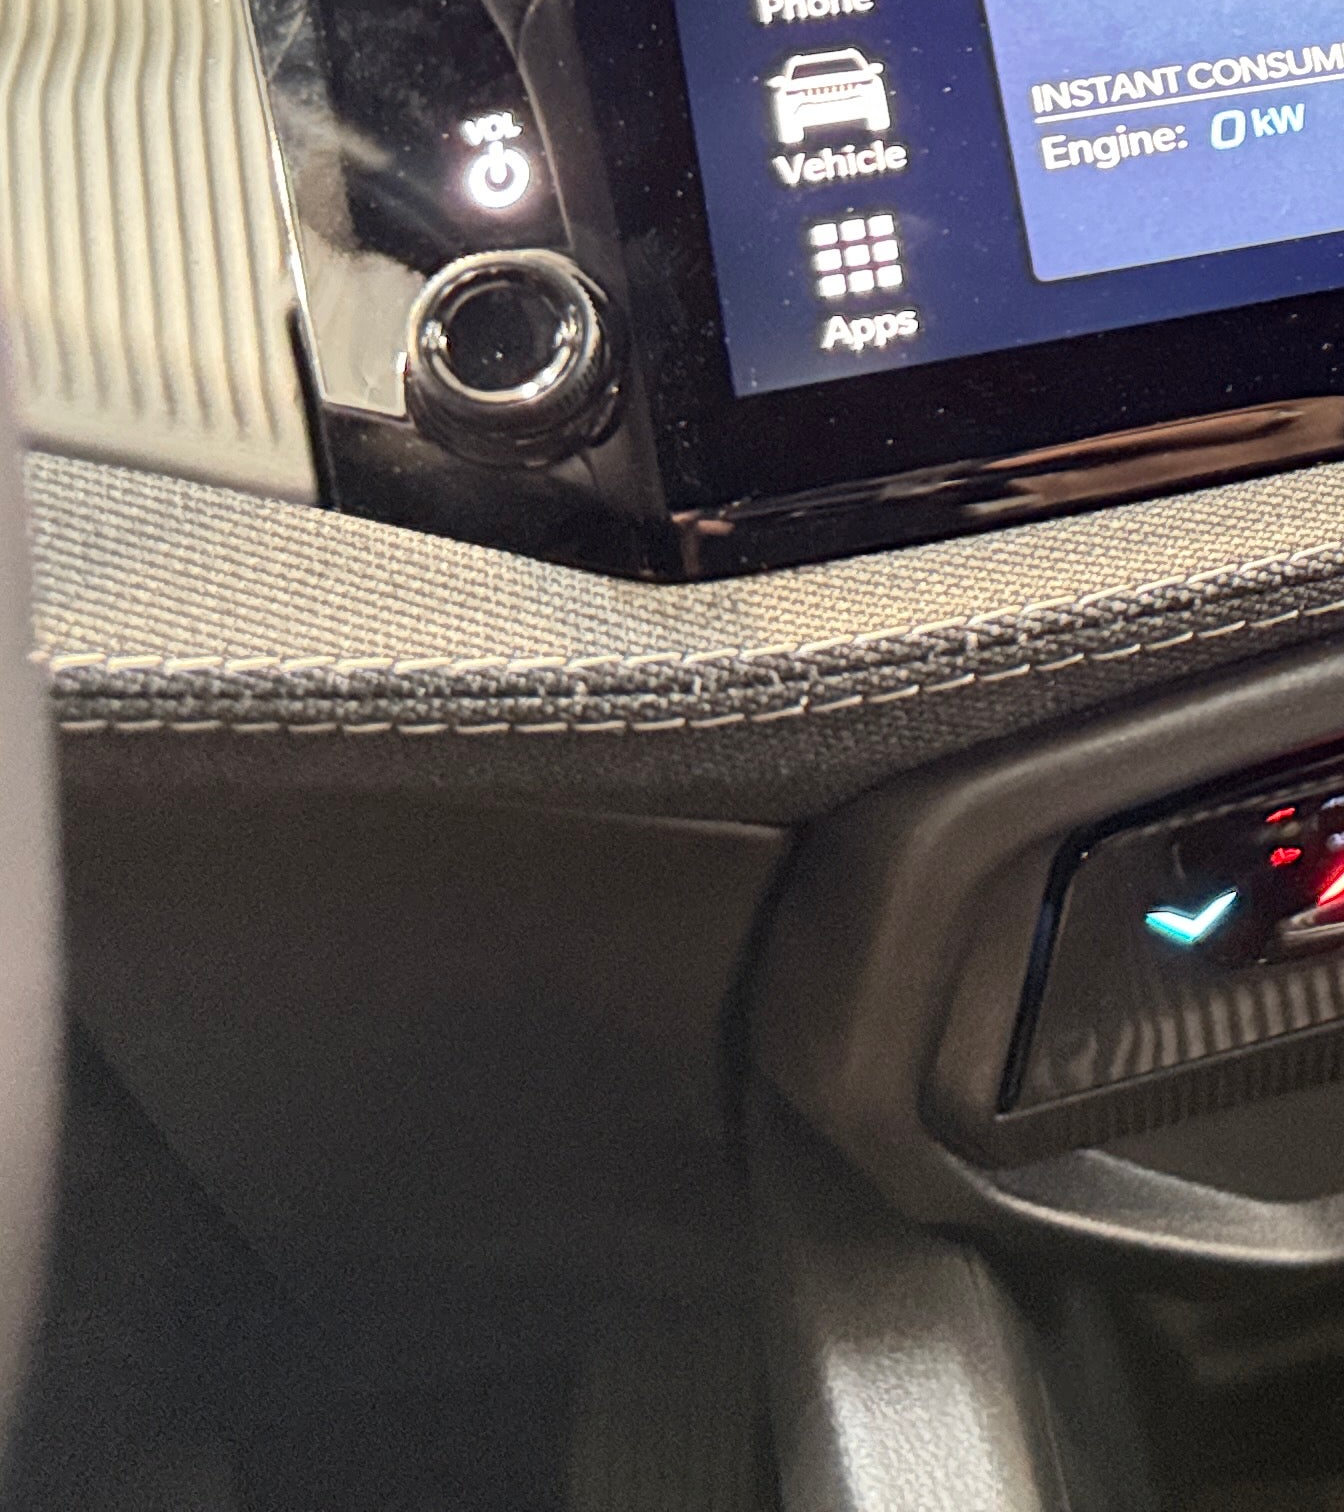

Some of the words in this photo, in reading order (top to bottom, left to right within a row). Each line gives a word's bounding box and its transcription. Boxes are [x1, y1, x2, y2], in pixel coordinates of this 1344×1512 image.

[1029, 64, 1184, 114] INSTANT
[460, 110, 524, 147] VOL
[1040, 123, 1189, 170] Engine:
[1209, 108, 1248, 152] 0
[1251, 102, 1306, 139] kW
[771, 141, 908, 186] Vehicle
[820, 308, 919, 352] Apps
